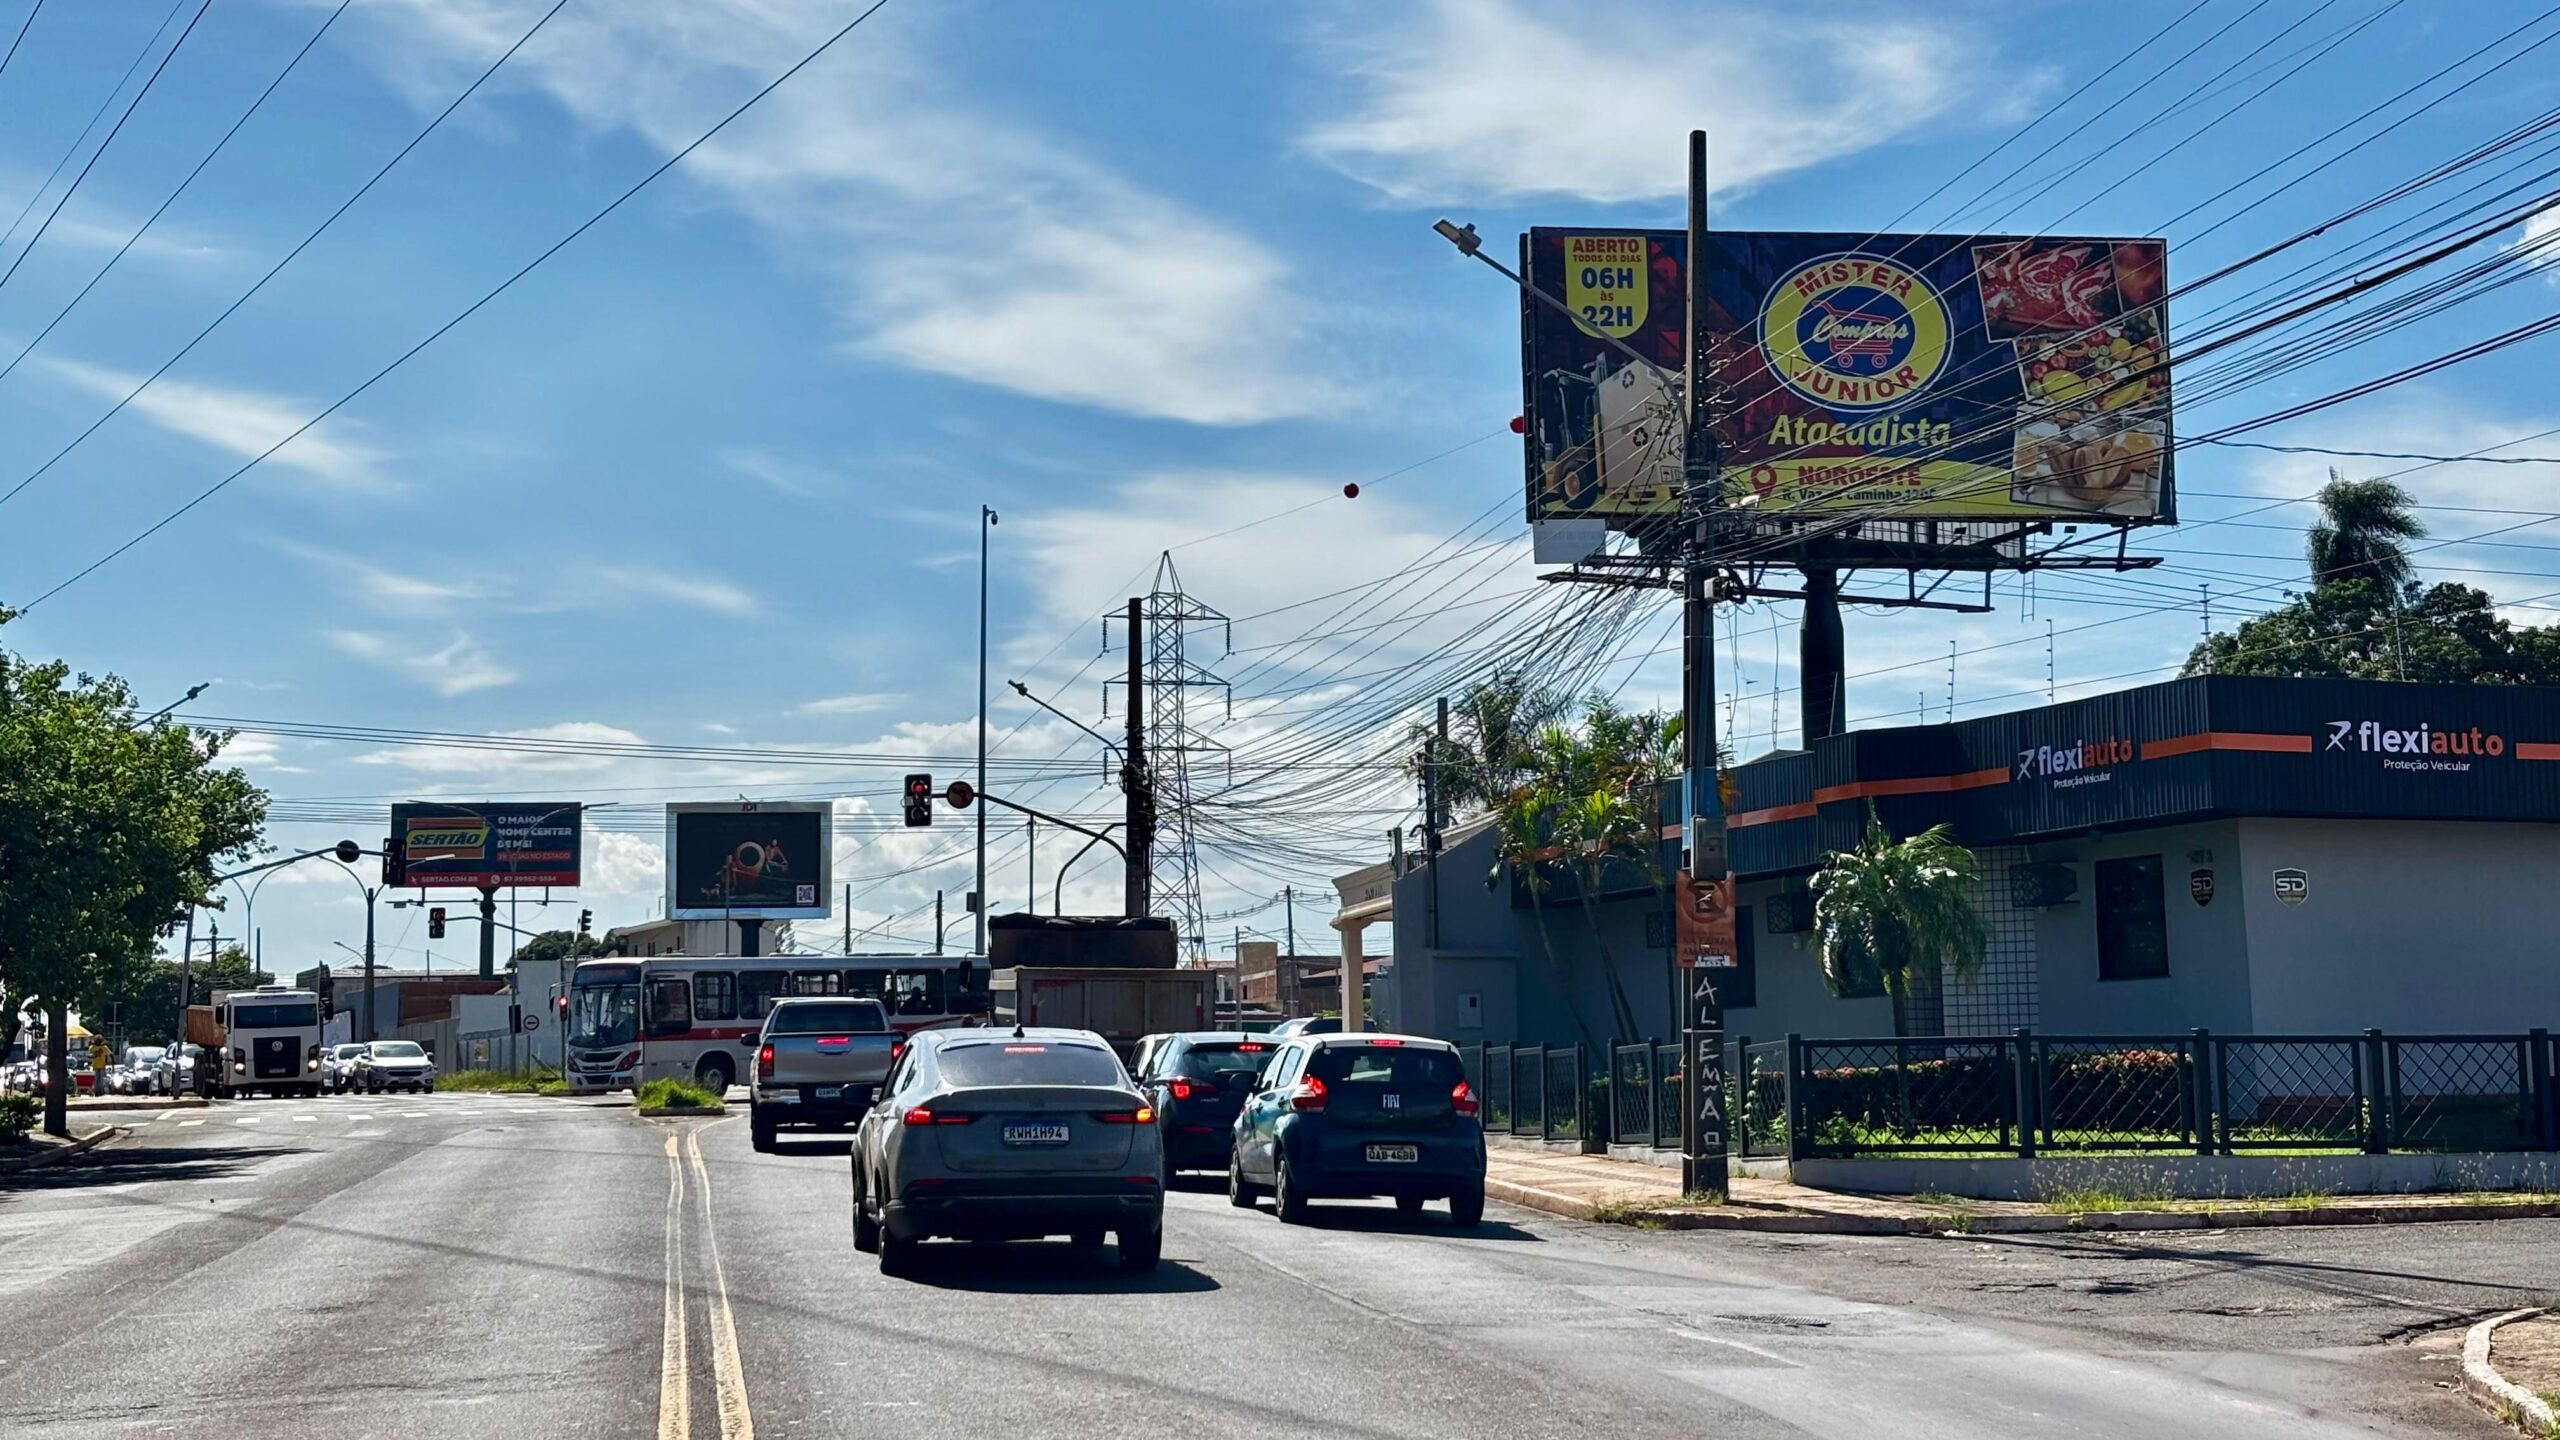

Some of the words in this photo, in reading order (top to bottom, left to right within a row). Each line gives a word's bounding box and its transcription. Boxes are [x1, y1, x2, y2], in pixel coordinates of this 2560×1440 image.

[1572, 239, 1640, 253] ABERTO
[1573, 254, 1603, 263] TODOS
[1605, 254, 1618, 263] OS
[1581, 267, 1634, 289] 06H
[1600, 291, 1615, 302] às
[1582, 305, 1634, 327] 22H
[1812, 314, 1909, 343] Compras
[1768, 414, 1951, 446] Atacadista
[1798, 466, 1921, 486] NOROESTE
[2358, 721, 2504, 757] flexiauto
[2038, 736, 2133, 775] flexiauto
[2384, 759, 2428, 771] Proteção
[2430, 760, 2470, 771] Veicular
[498, 816, 506, 824] O
[508, 816, 545, 824] MAIOR
[410, 831, 480, 846] SERTÃO
[497, 828, 530, 836] HOME
[531, 827, 572, 836] CENTER
[2191, 877, 2213, 891] SD
[2276, 878, 2306, 891] SD
[1382, 1094, 1400, 1109] FIAT
[1008, 1127, 1063, 1139] RWH1H94
